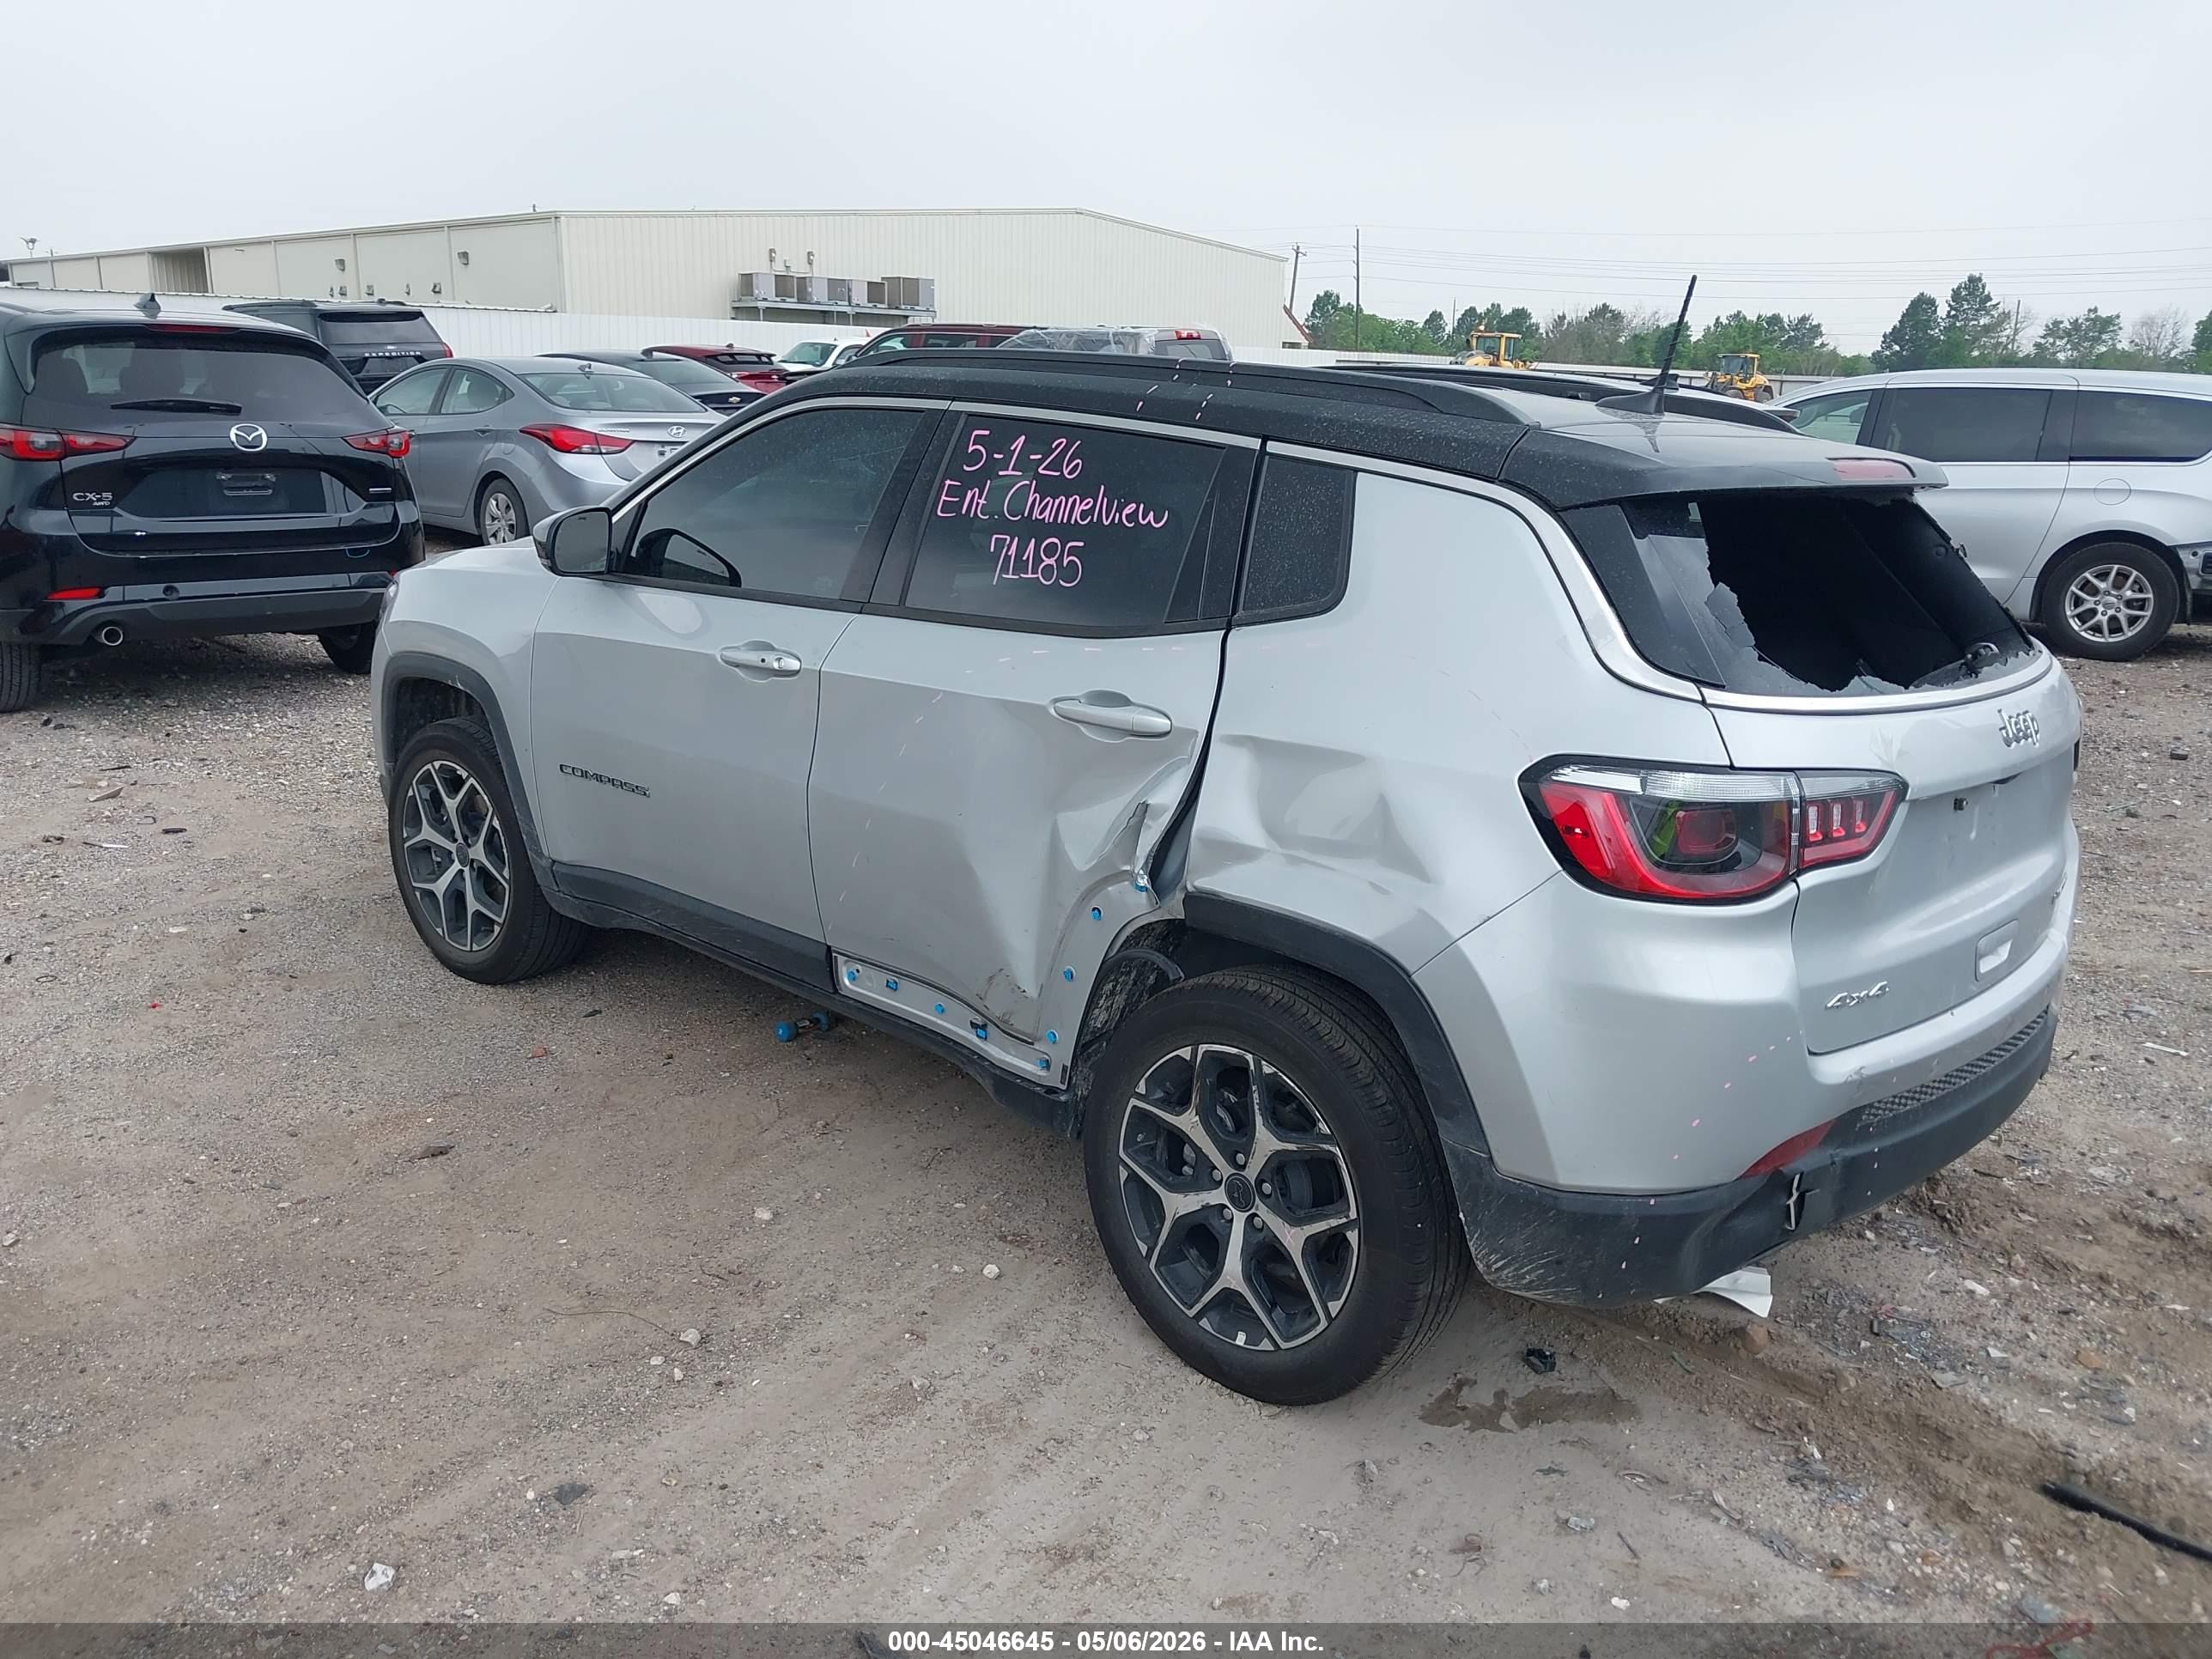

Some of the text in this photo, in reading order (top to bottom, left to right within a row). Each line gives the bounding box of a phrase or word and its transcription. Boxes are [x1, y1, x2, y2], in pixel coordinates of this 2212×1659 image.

[963, 429, 1083, 479] 5-1-26
[72, 492, 113, 501] CX-5
[937, 478, 1169, 528] Ent. Channelview
[989, 533, 1085, 587] 71185
[1996, 708, 2040, 749] Jeep
[559, 763, 651, 798] COMPASS
